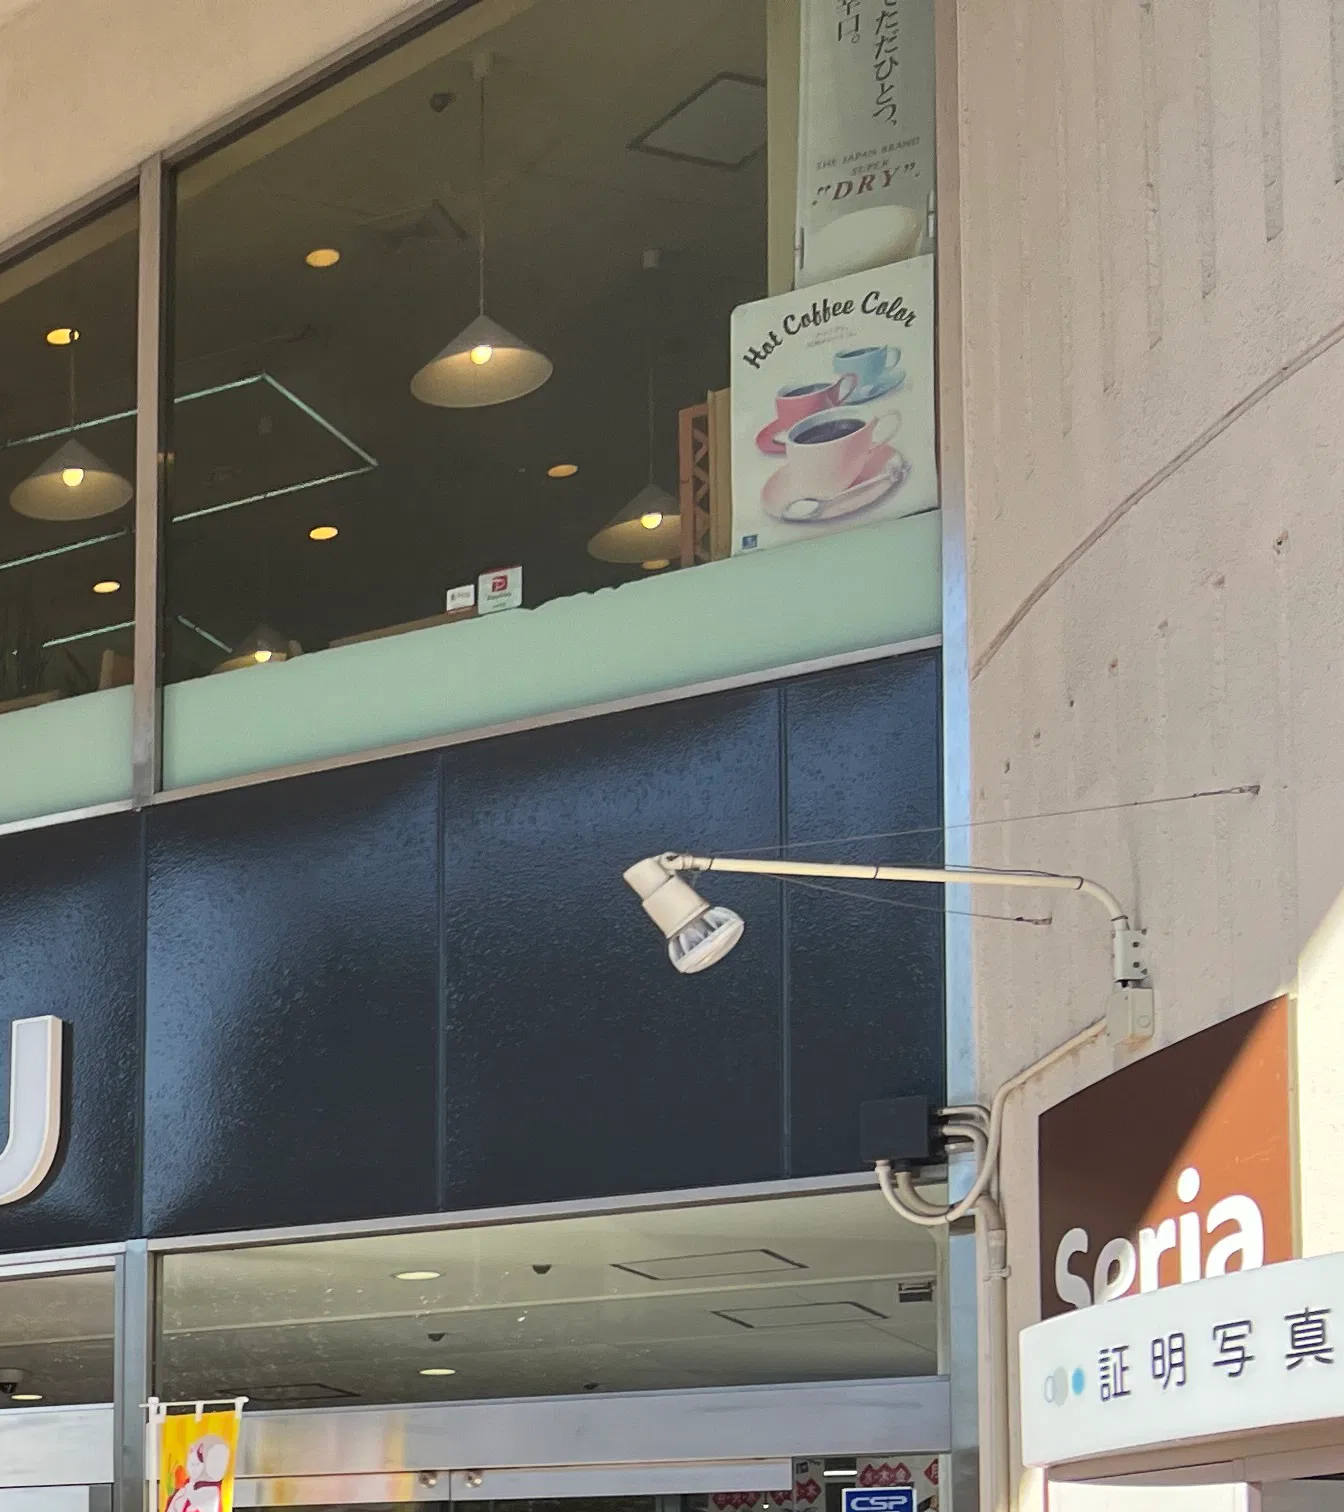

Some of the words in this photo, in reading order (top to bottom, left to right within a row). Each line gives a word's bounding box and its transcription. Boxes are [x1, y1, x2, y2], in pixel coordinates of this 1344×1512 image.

[872, 0, 899, 126] ただひとつ、
[743, 330, 783, 369] Hot
[783, 298, 855, 335] Coffee
[861, 290, 917, 328] Color
[1098, 1307, 1335, 1402] 証明写真
[851, 1495, 909, 1510] CSP
